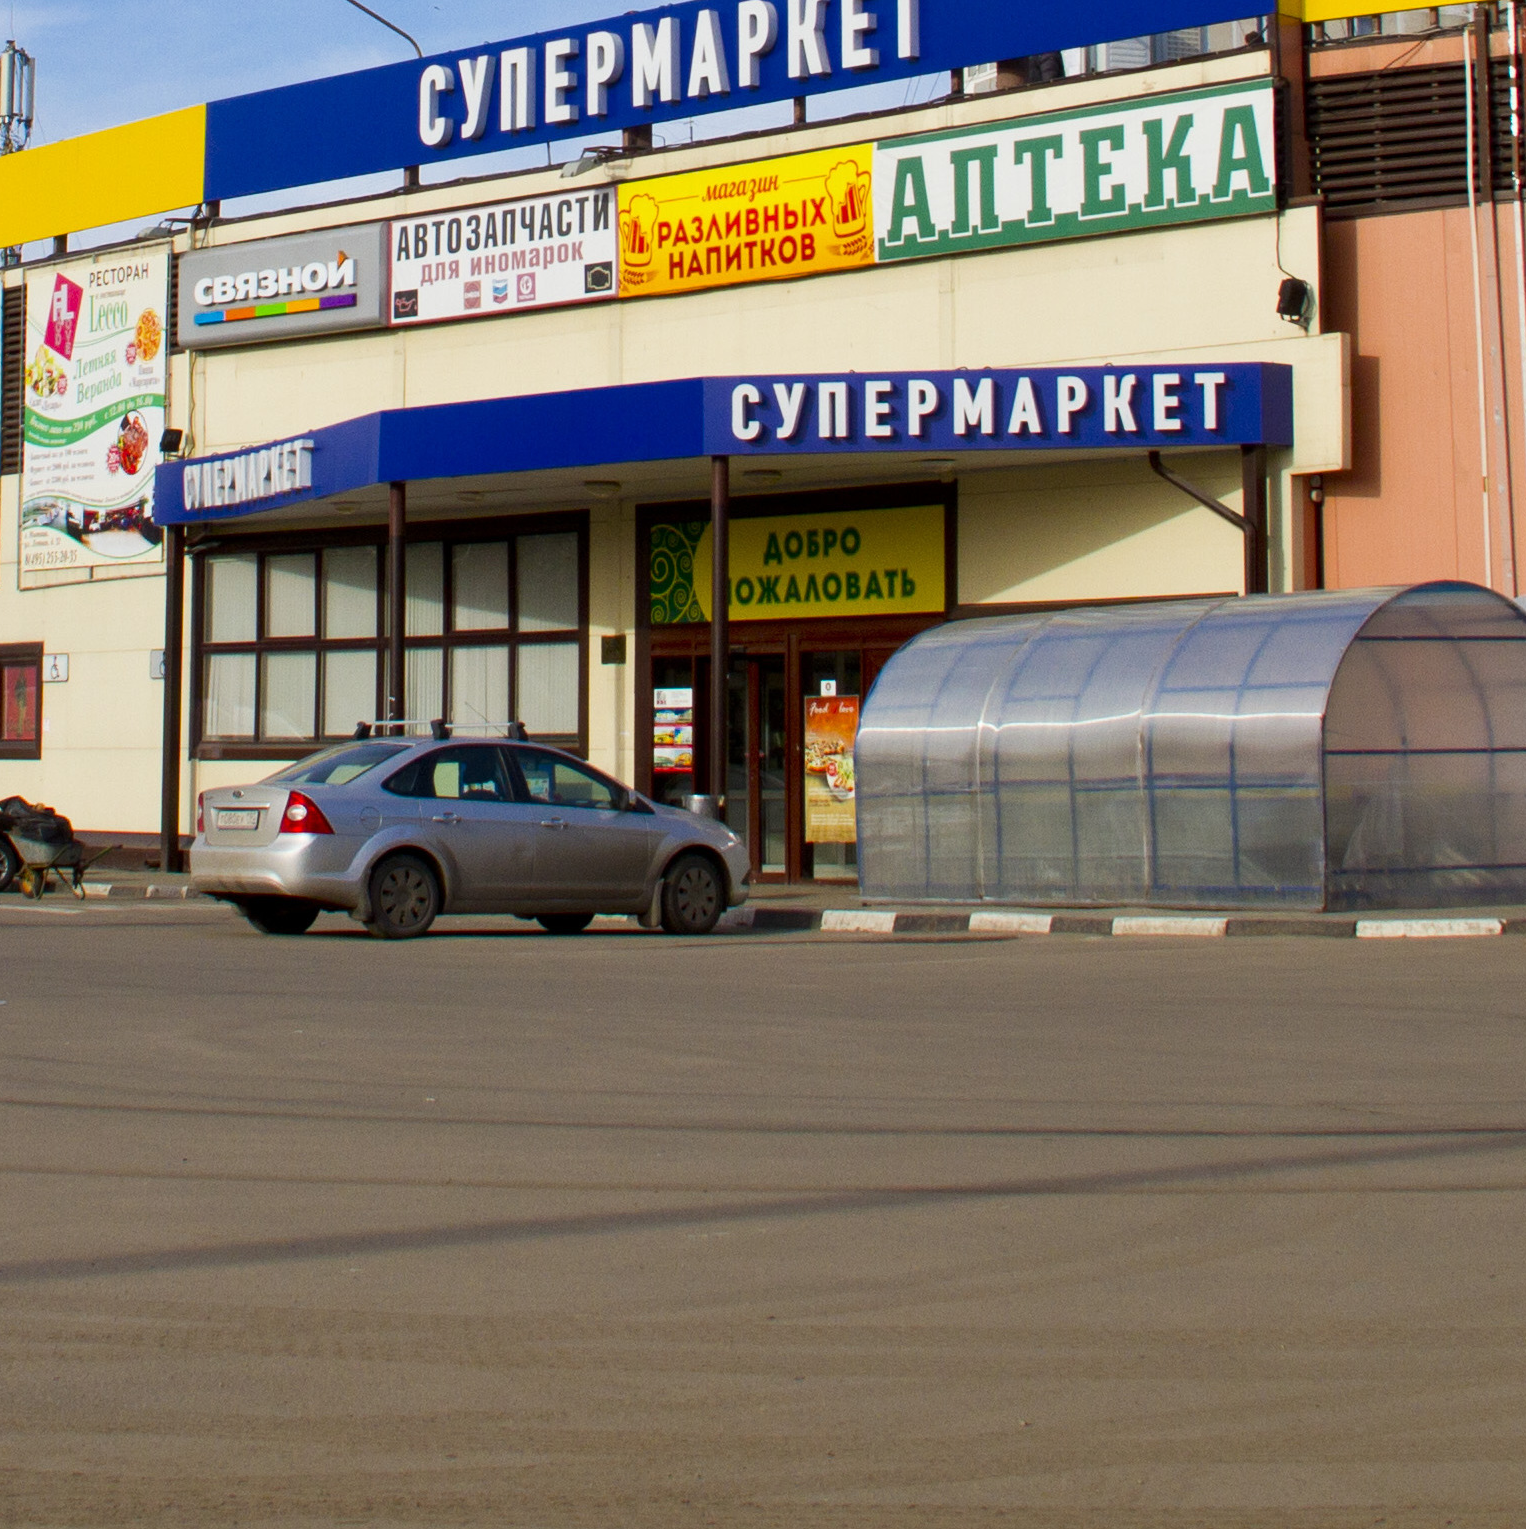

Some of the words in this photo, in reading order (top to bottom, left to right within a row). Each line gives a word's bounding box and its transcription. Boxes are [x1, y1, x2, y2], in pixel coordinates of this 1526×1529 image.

[702, 175, 779, 202] магазин
[886, 104, 1270, 244] АПТЕКА
[397, 192, 610, 262] АВТОЗАПЧАСТИ
[657, 197, 827, 249] РАЗЛИВНЫХ
[89, 263, 149, 288] РЕСТОРАН
[194, 250, 357, 306] СВЯЗНОЙ
[420, 260, 460, 287] для
[470, 241, 584, 276] иномарок
[668, 233, 816, 280] НАПИТКОВ
[90, 295, 128, 333] Lecco
[72, 349, 117, 380] Летняя
[76, 369, 122, 404] Веранда
[731, 372, 1226, 441] СУПЕРМАРКЕТ
[183, 439, 315, 511] СУПЕРМАРКЕТ
[763, 526, 862, 566] ДОБРО
